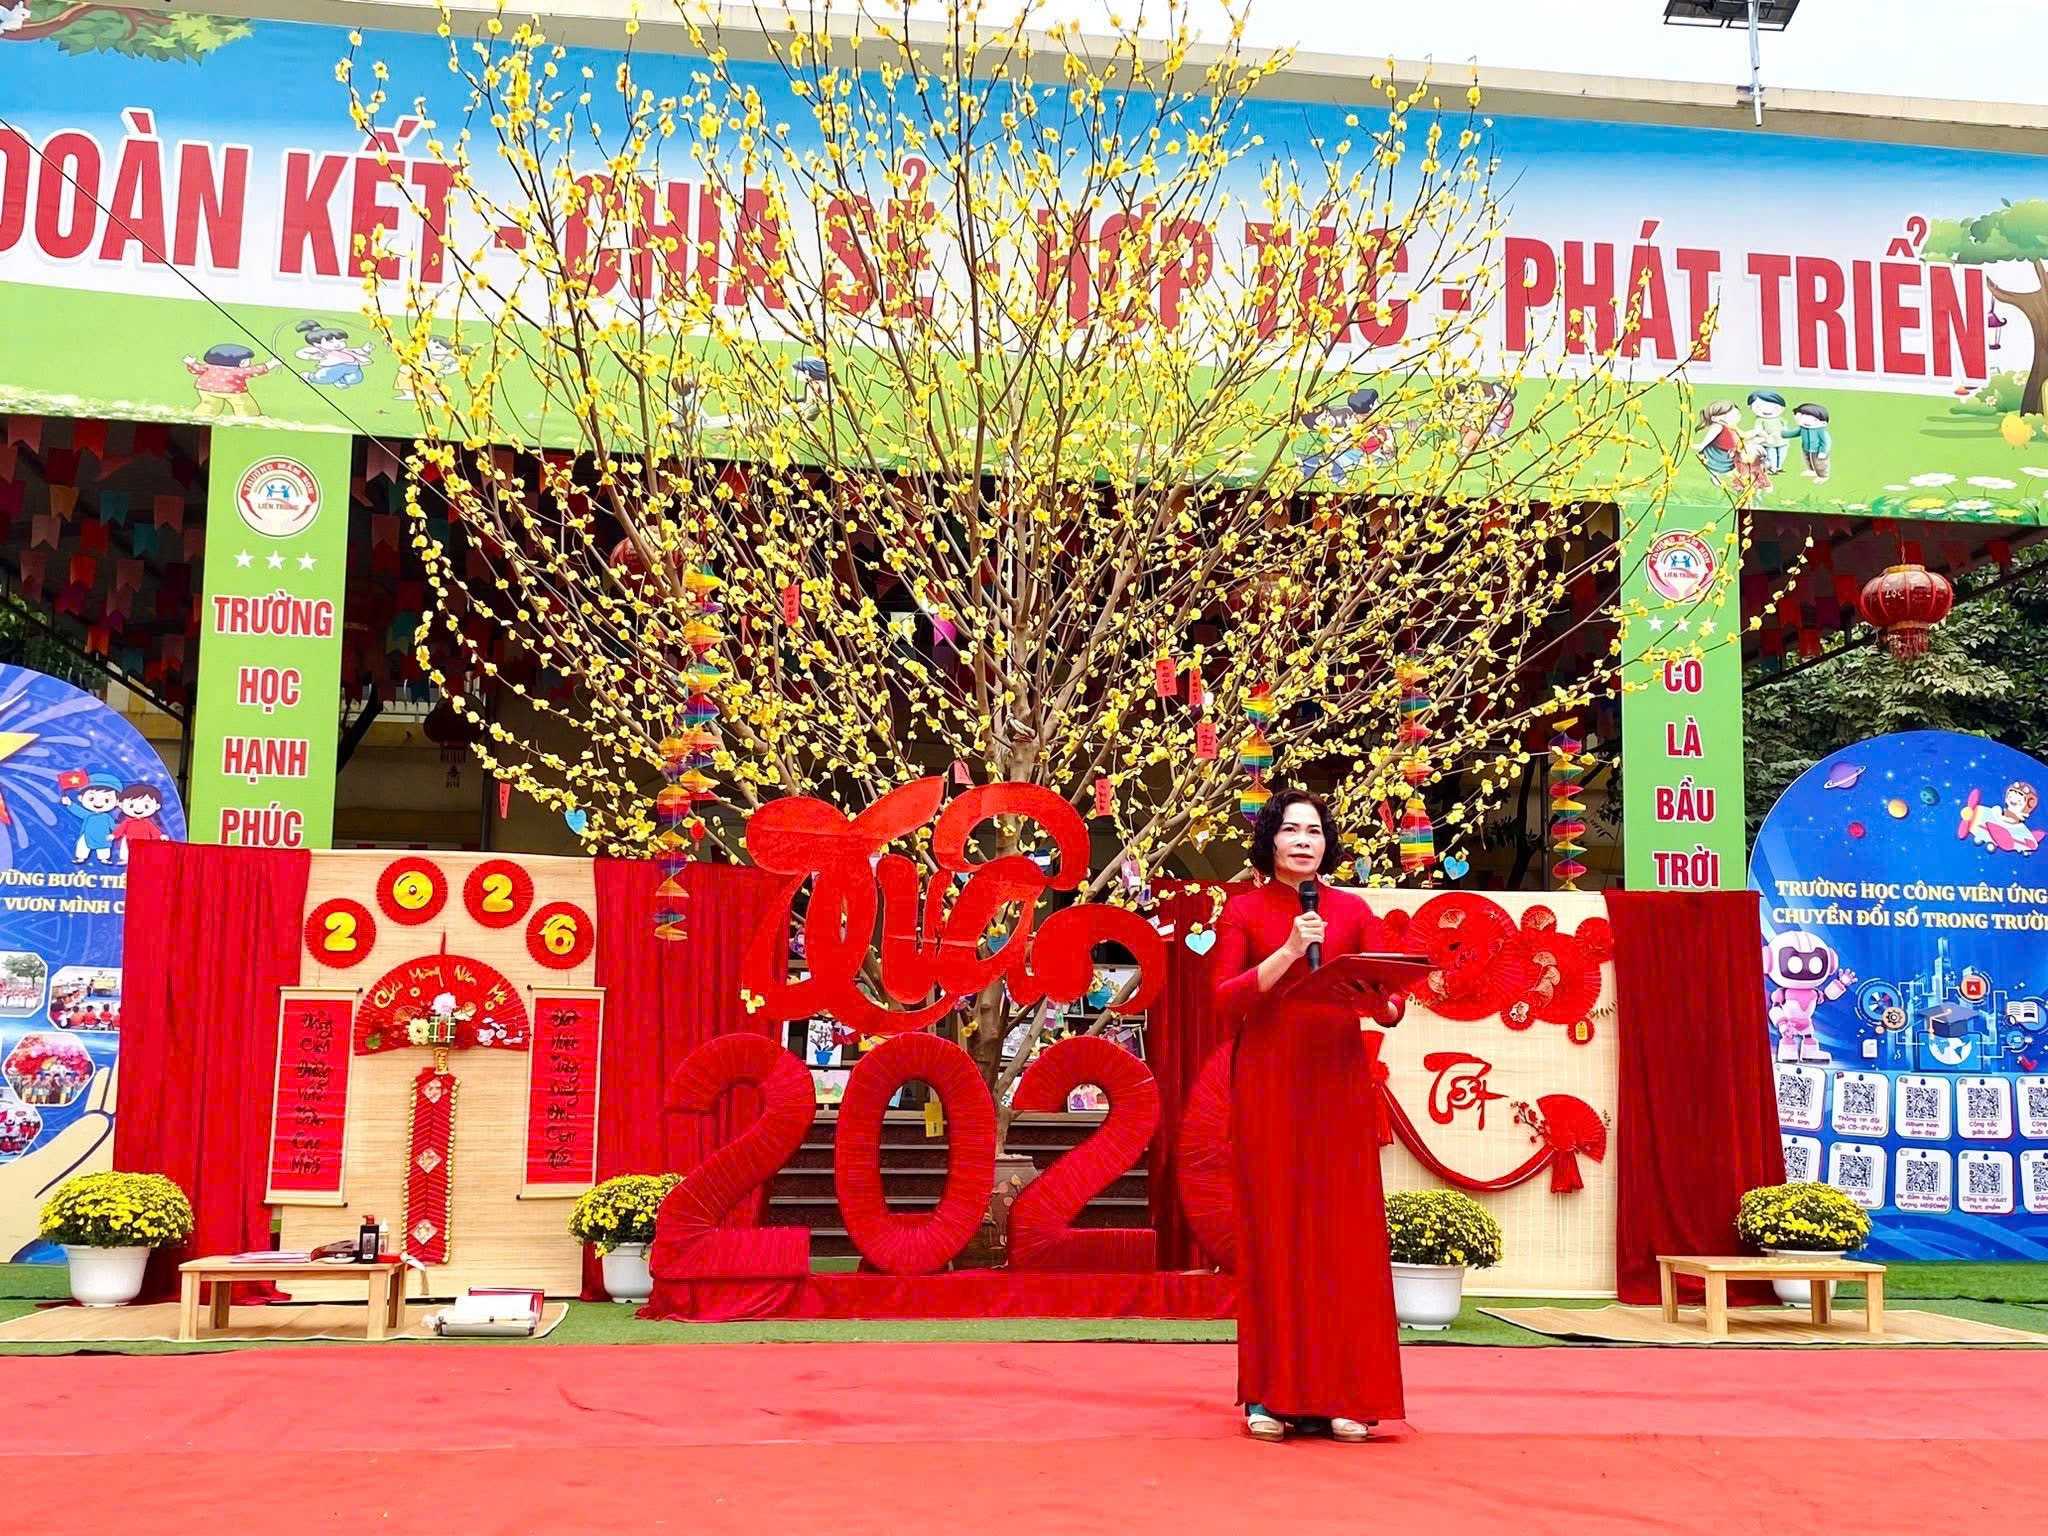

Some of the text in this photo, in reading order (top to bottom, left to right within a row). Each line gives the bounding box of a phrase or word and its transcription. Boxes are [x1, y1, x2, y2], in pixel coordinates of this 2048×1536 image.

[279, 119, 464, 284] KẾT
[565, 175, 786, 309] CHIA
[1245, 204, 1409, 347] TÁC
[1505, 221, 1720, 362] PHÁT
[1747, 216, 1987, 379] TRIỂN
[214, 590, 333, 637] TRƯỜNG
[240, 669, 300, 712] HỌC
[1667, 717, 1702, 757] LÀ
[223, 738, 307, 783] HẠNH
[1657, 778, 1715, 822] BẦU
[221, 802, 302, 847] PHÚC
[48, 870, 97, 888] BƯỚC
[1654, 846, 1719, 887] TRỜI
[4, 896, 56, 912] VƯƠN
[60, 895, 111, 914] MÌNH
[1775, 876, 2048, 905] TRƯỜNG HỌC CÔNG VIÊN ỨNG
[1772, 903, 1853, 926] CHUYỂN
[1857, 905, 1890, 927] ĐỔI
[1894, 907, 1919, 927] SỐ
[1922, 913, 1988, 929] TRONG
